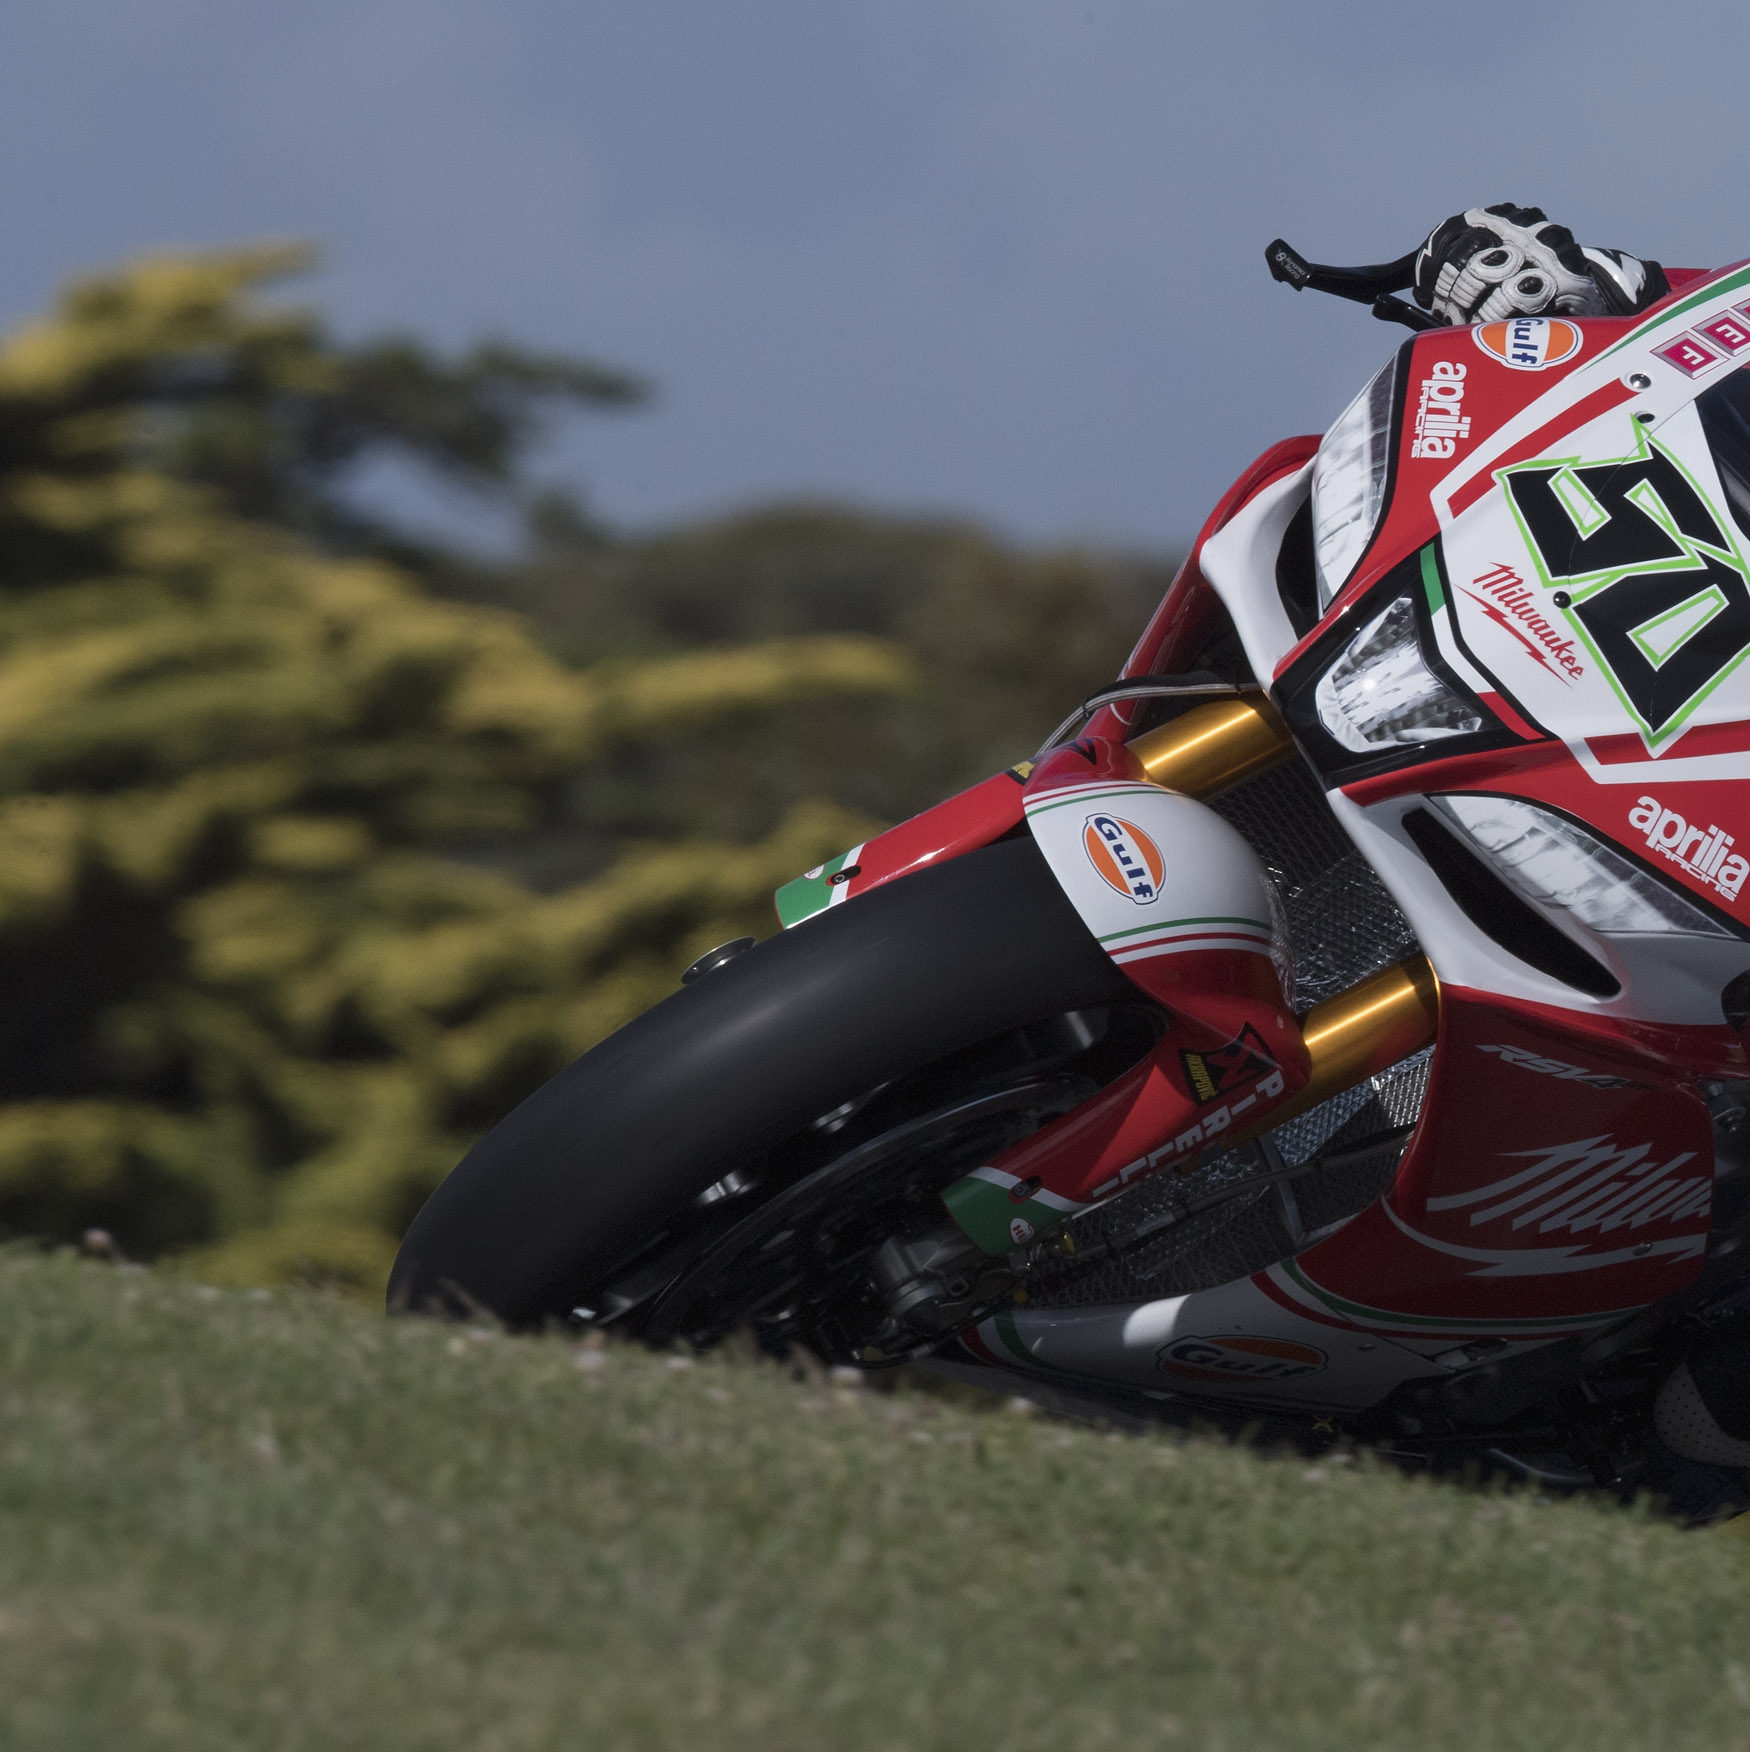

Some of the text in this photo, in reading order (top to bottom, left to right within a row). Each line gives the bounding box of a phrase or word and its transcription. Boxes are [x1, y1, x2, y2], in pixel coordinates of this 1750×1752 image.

[1511, 318, 1544, 365] Gulf
[1420, 361, 1472, 459] aprilia
[1472, 562, 1584, 681] Milwaukee
[1094, 816, 1154, 898] Gulf
[1628, 796, 1750, 895] aprilia
[1654, 843, 1738, 902] RACING
[1091, 1069, 1286, 1199] PIRELLI
[1172, 1343, 1317, 1378] Gulf
